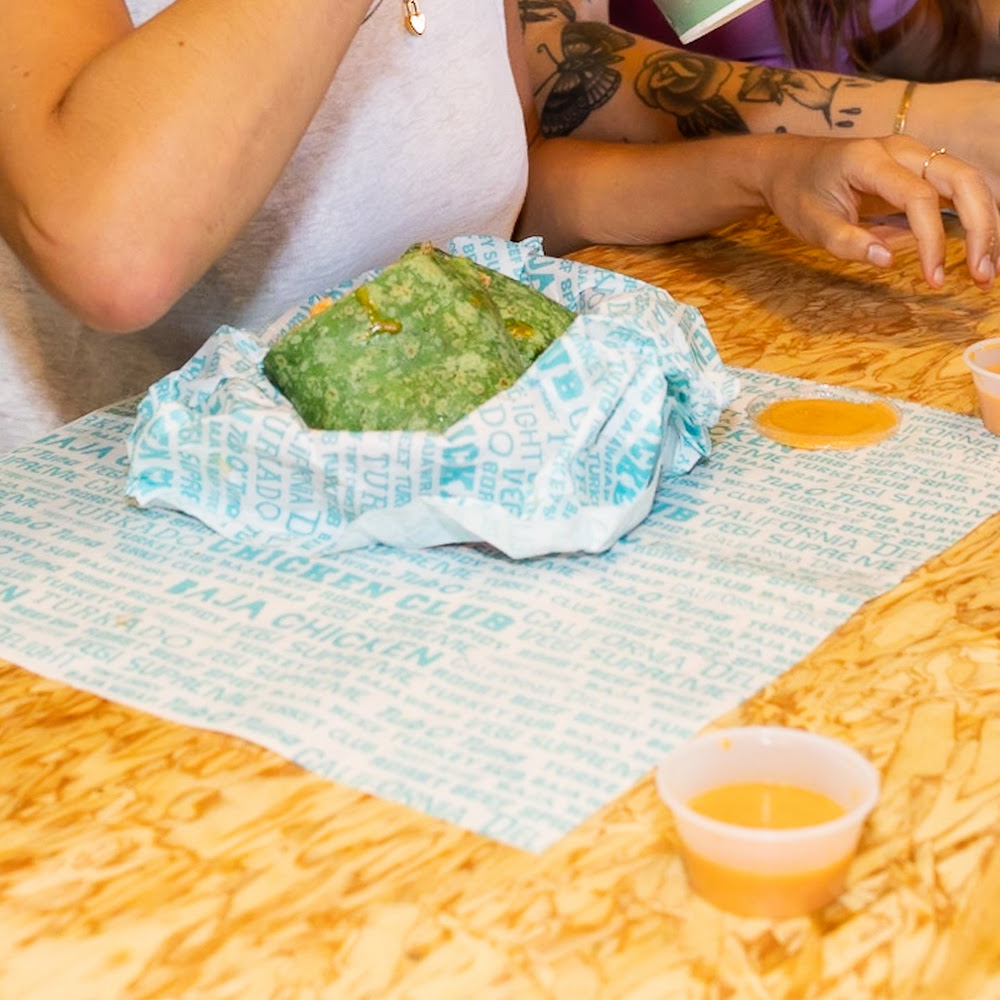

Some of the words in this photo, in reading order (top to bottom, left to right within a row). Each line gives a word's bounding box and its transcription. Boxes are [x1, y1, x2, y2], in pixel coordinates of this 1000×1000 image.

[902, 423, 1000, 452] IFORNIA
[864, 457, 976, 485] SUPREME
[704, 503, 859, 550] CALIFORNIA
[909, 510, 977, 530] TURKE
[767, 533, 898, 571] SUPREME
[208, 538, 397, 598] CHICKEN
[394, 593, 516, 633] CLUB
[271, 612, 445, 668] CHICKEN
[523, 609, 687, 669] CALIFORNIA
